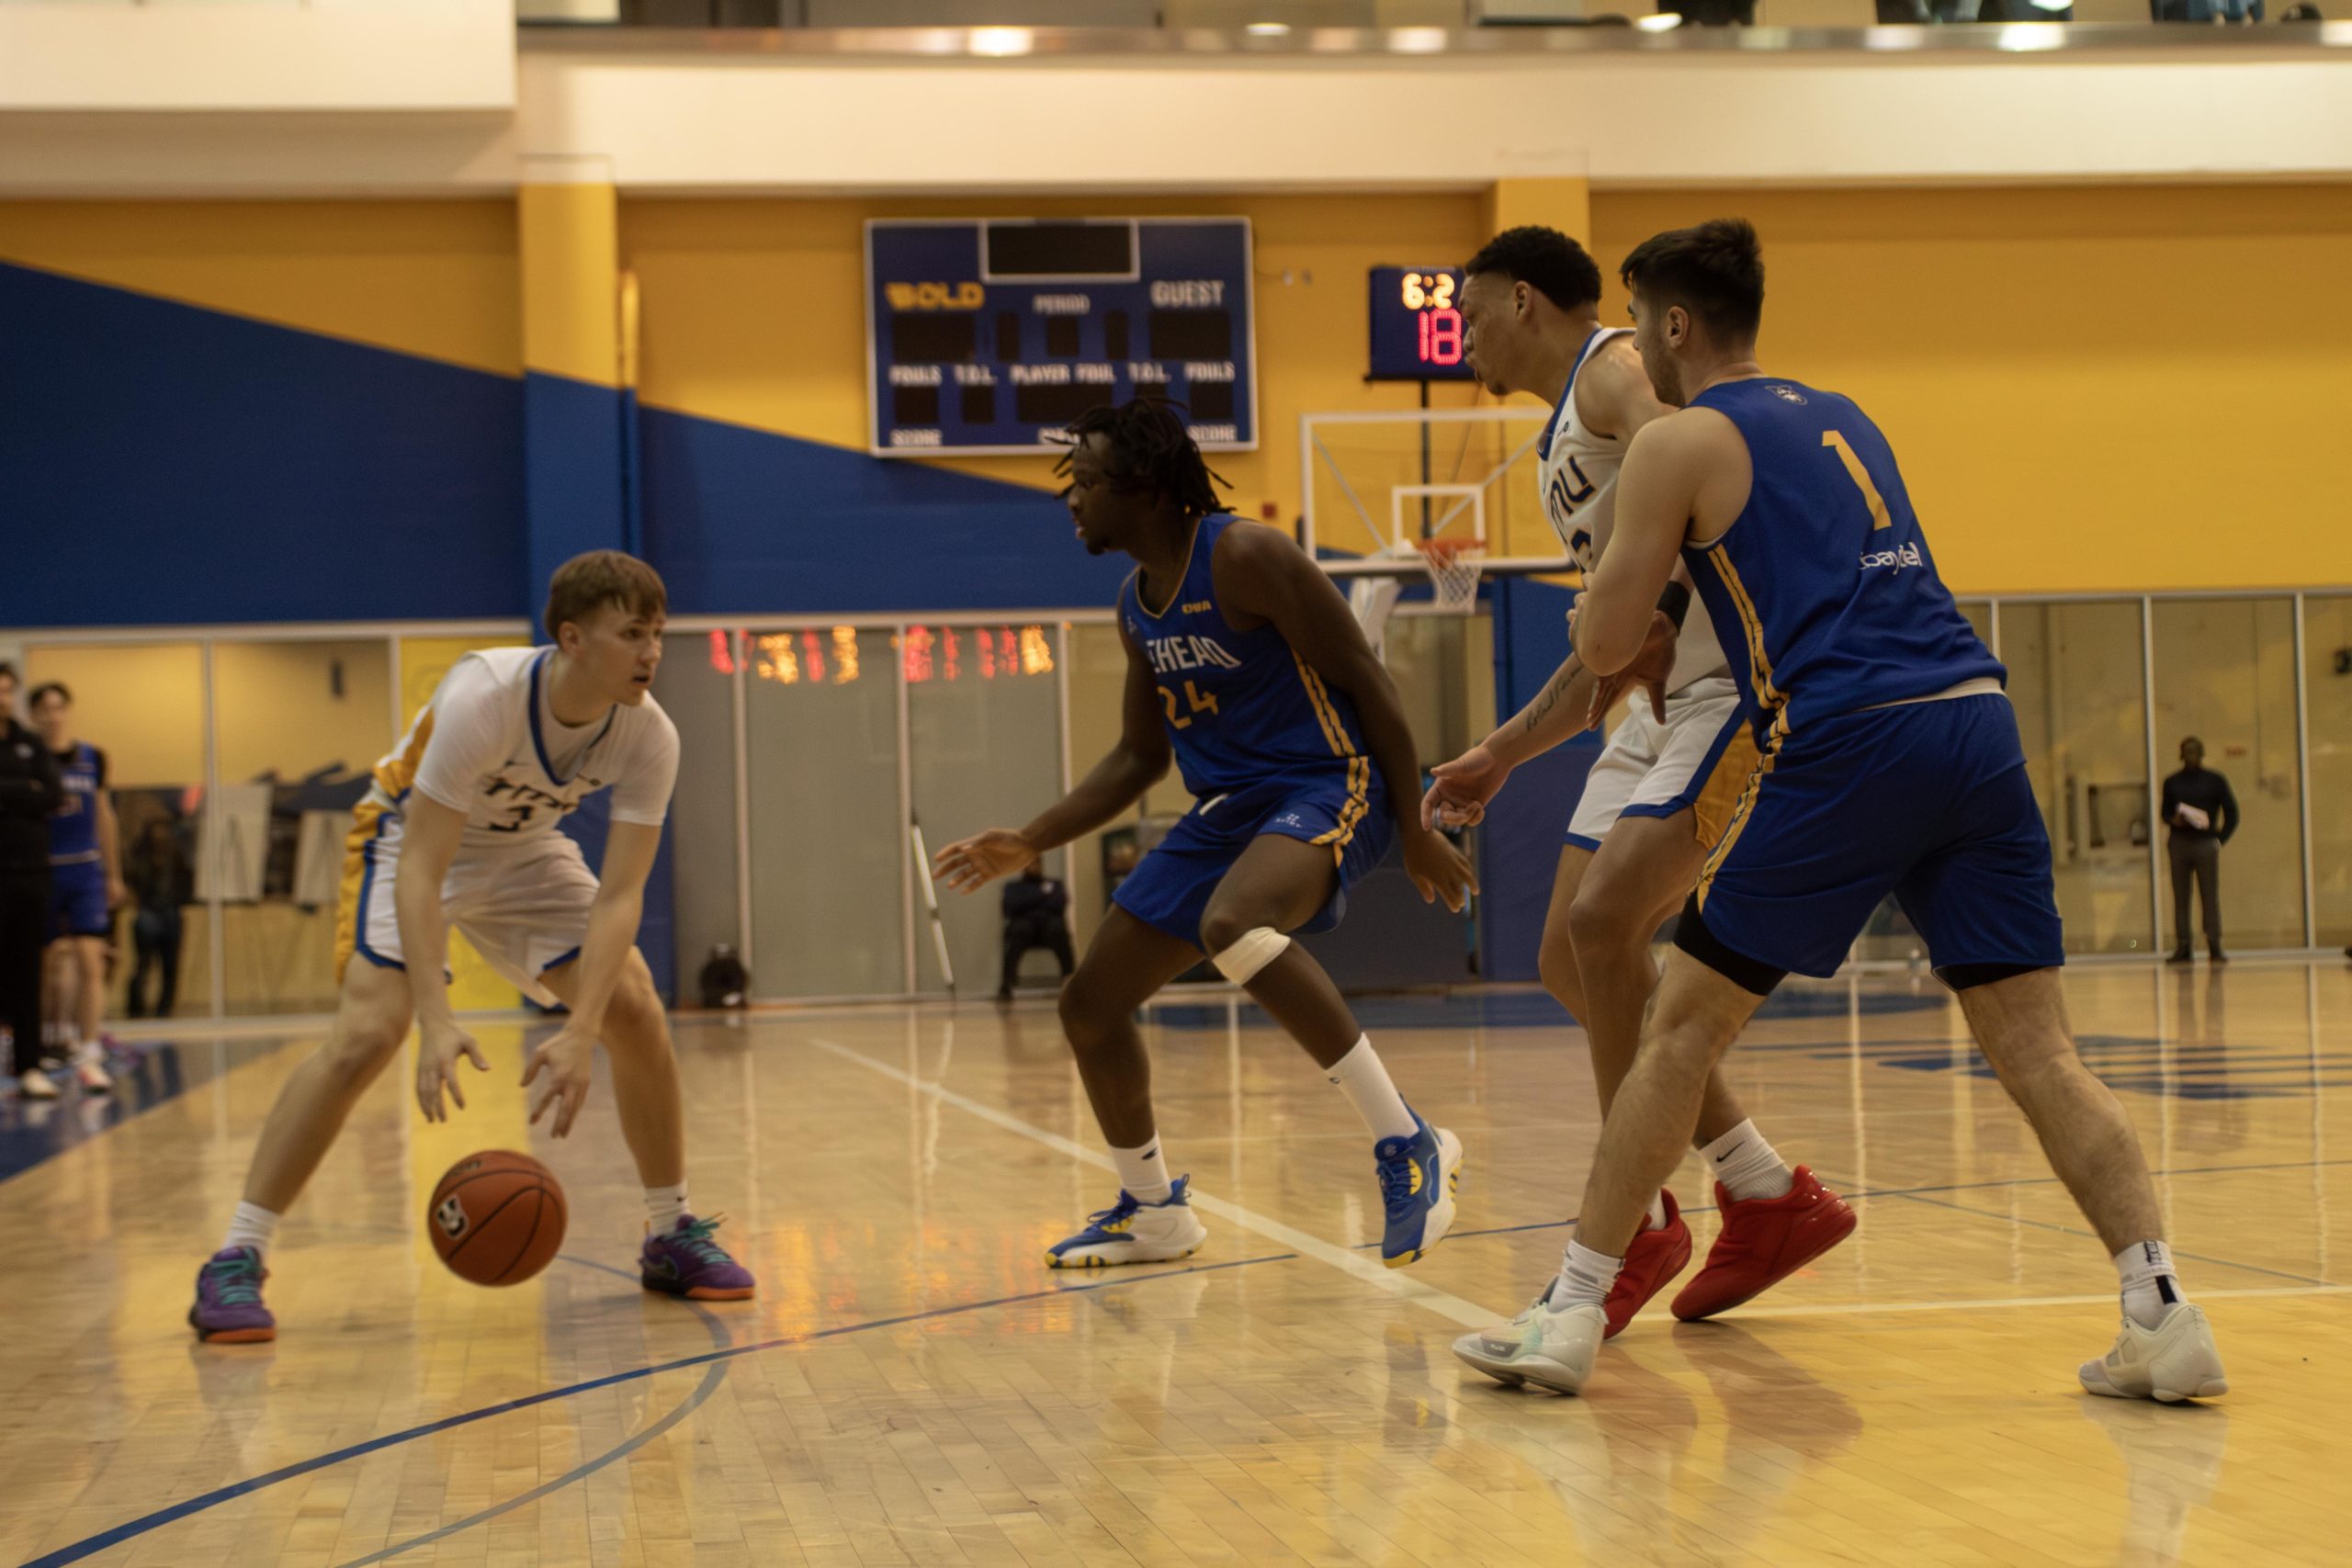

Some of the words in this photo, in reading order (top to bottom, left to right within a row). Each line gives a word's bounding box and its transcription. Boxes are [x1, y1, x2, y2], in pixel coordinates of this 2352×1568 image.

[1033, 294, 1091, 315] PERIOD
[1151, 280, 1225, 308] GUEST
[1419, 310, 1462, 366] 18
[889, 365, 943, 386] FOULS
[1010, 364, 1069, 386] PLAYER
[1183, 361, 1236, 383] FOULS
[1822, 430, 1893, 531] 1
[1158, 680, 1219, 729] 24
